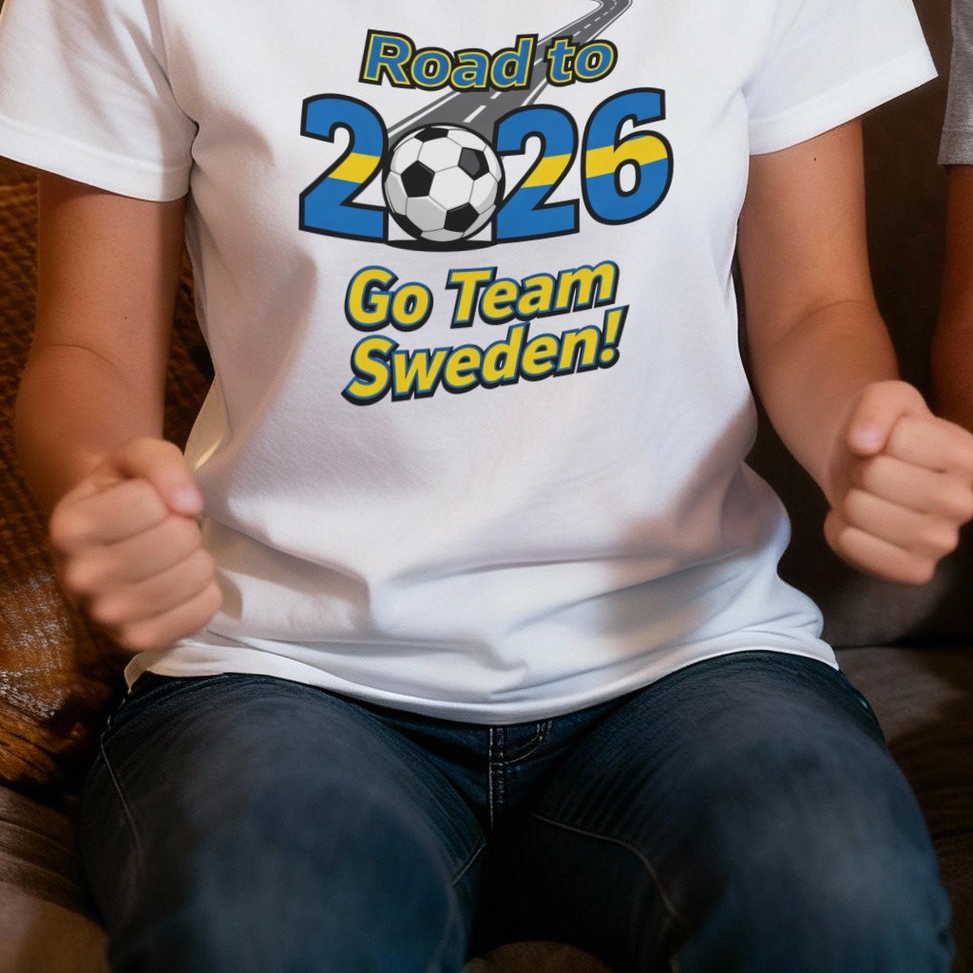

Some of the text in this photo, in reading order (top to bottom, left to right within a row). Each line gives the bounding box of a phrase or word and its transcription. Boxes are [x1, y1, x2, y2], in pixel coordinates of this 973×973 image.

[358, 29, 618, 92] Road to
[344, 259, 620, 332] Go Team
[341, 304, 630, 406] Sweden!
